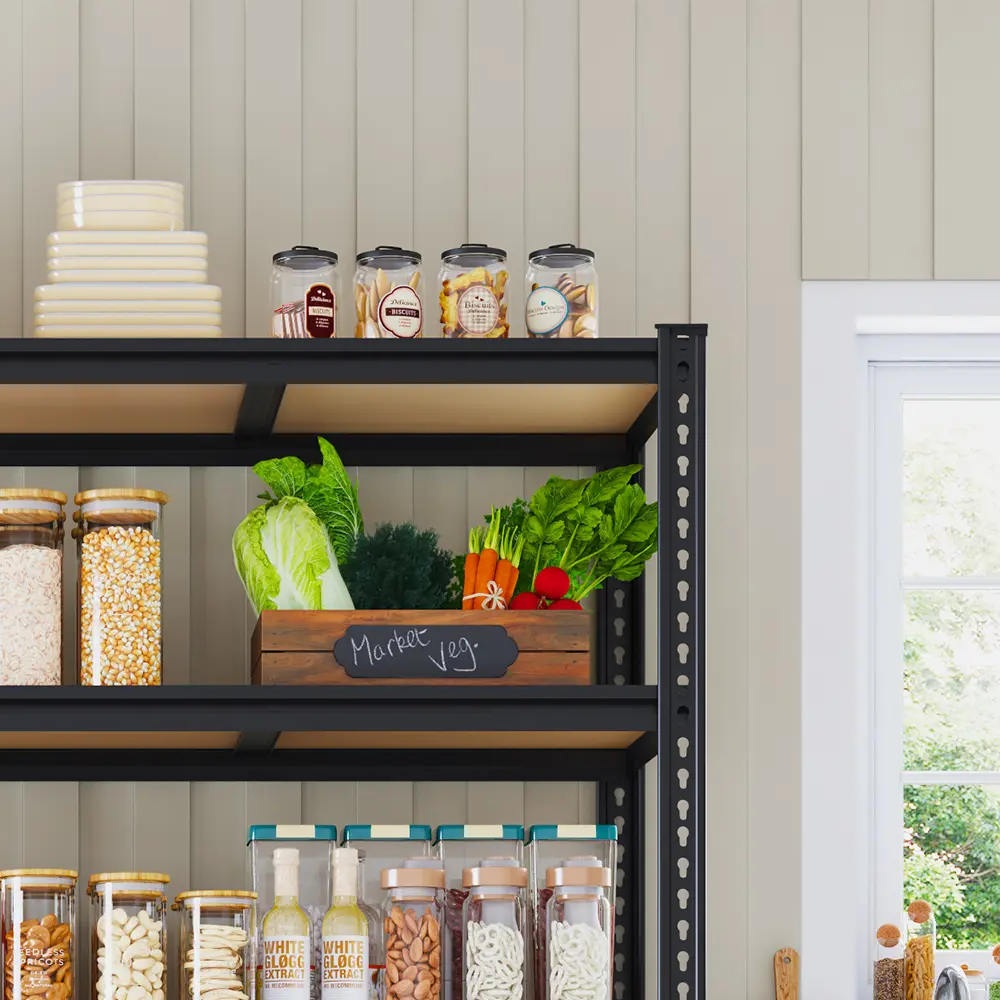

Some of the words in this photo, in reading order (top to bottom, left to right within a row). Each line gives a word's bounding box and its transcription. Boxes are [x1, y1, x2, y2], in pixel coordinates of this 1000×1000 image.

[350, 628, 432, 666] Market
[264, 941, 304, 954] WHITE
[323, 941, 364, 954] WHITE
[265, 955, 304, 968] GLØGG
[324, 955, 364, 968] GLØGG
[265, 969, 304, 979] EXTRACT
[324, 969, 364, 979] EXTRACT
